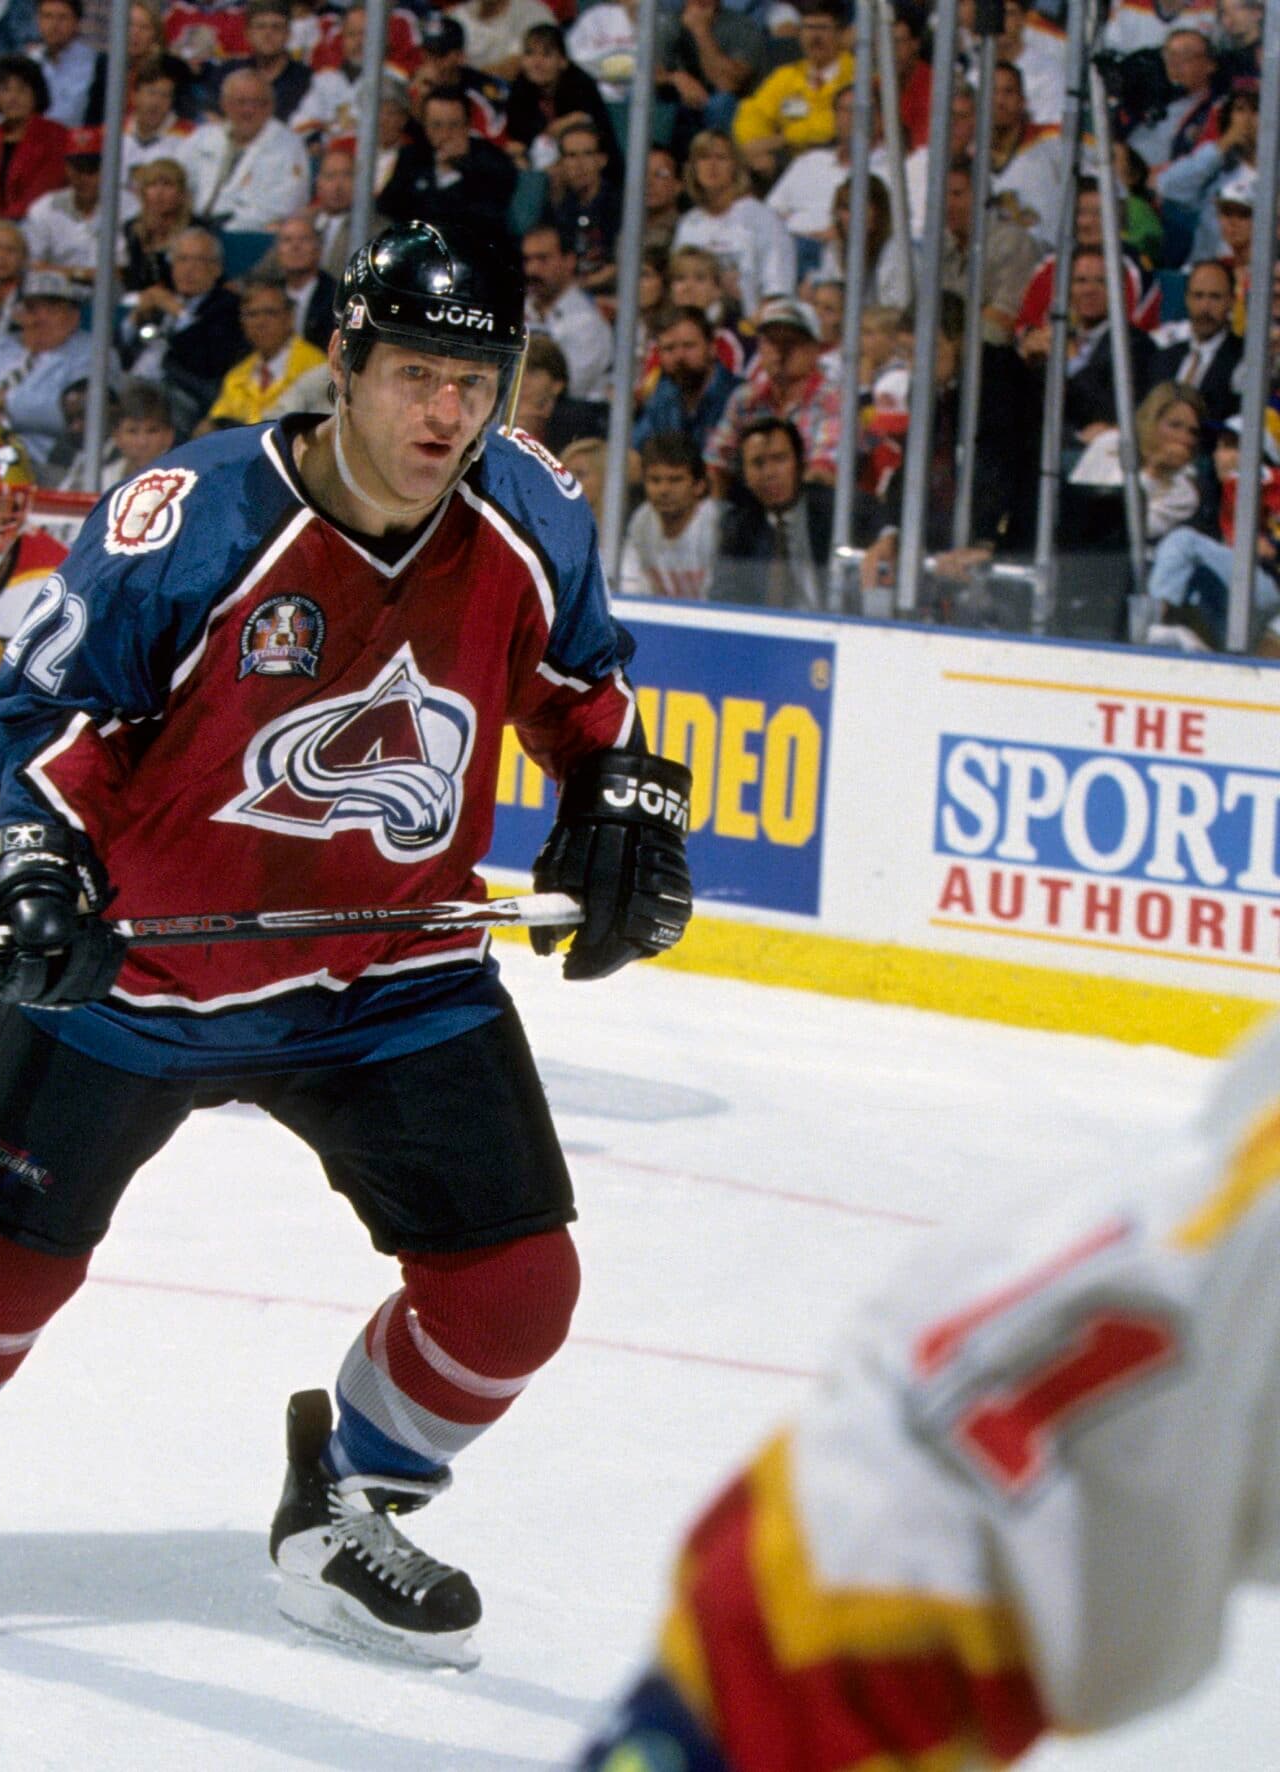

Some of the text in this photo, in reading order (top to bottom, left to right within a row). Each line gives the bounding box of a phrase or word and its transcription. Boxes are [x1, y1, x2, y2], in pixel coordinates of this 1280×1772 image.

[425, 304, 495, 332] JOFA
[3, 572, 87, 697] 22
[1096, 701, 1206, 756] THE
[603, 777, 690, 832] JOFA
[938, 865, 1280, 954] AUTHORI
